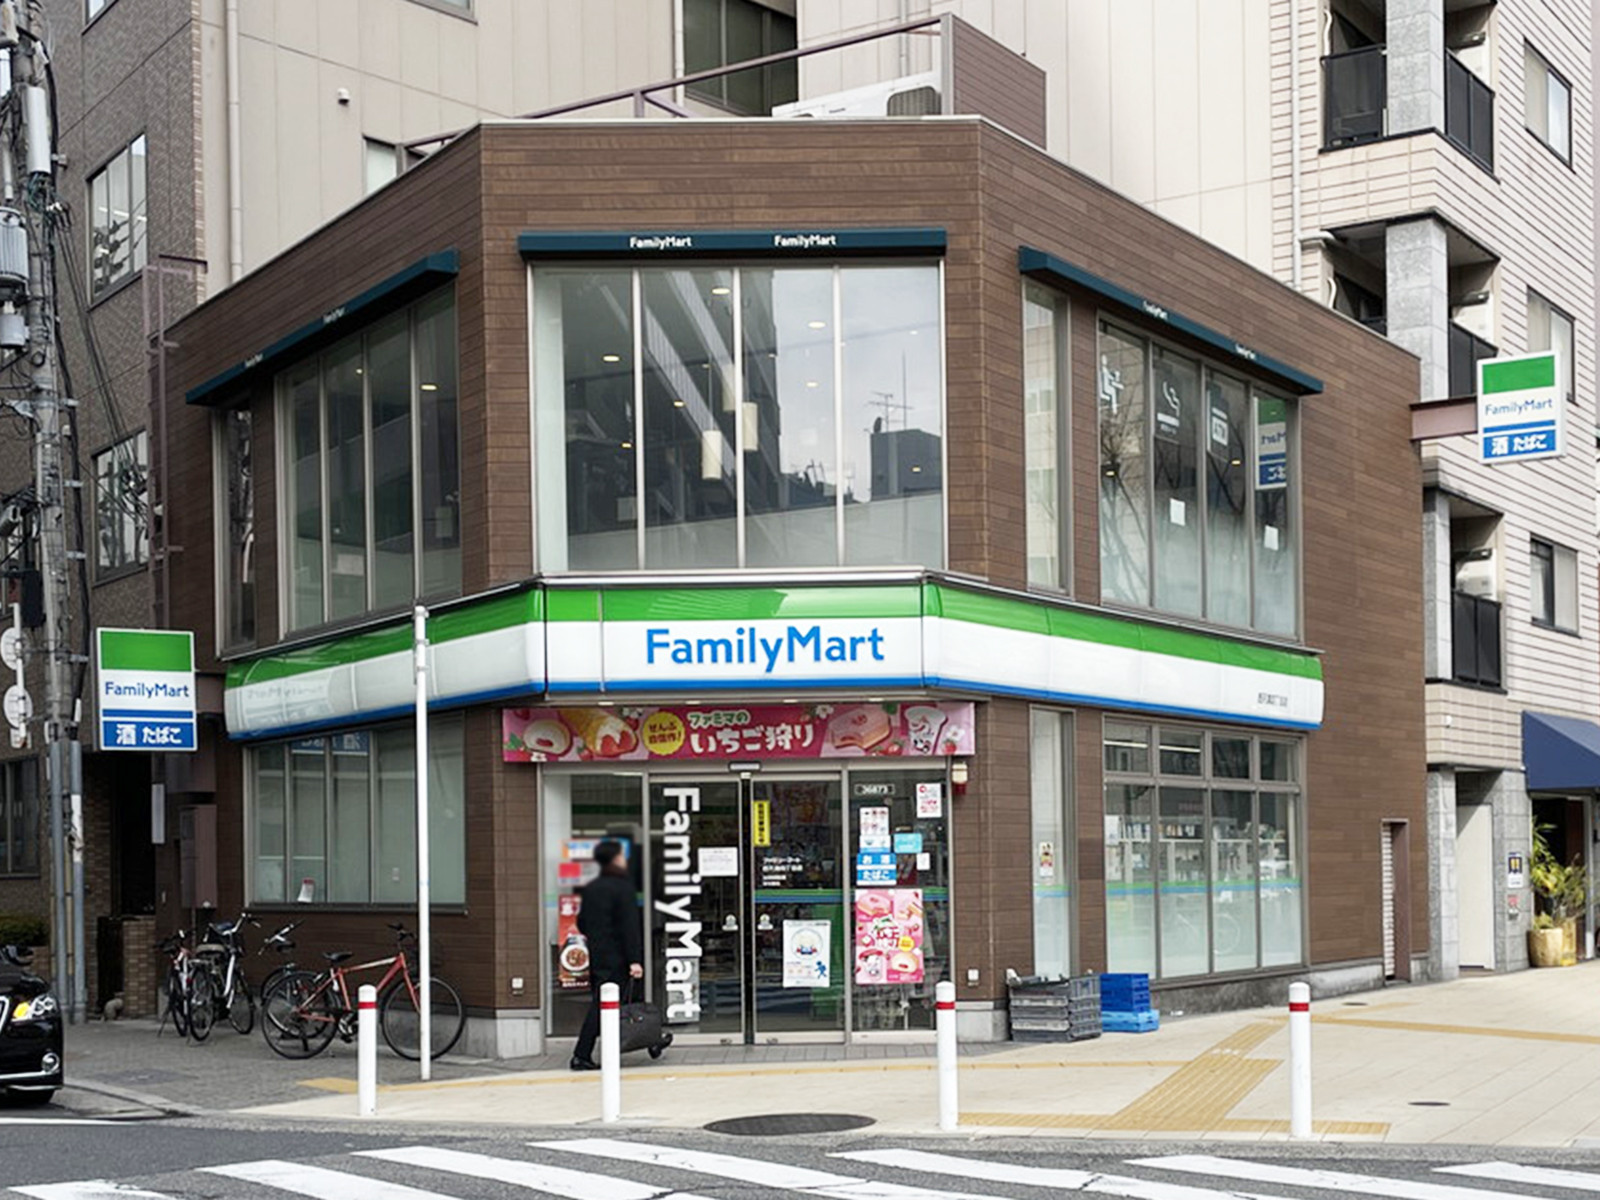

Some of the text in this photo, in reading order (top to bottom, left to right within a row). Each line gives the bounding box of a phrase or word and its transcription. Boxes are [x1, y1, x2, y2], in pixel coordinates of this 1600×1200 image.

[629, 237, 692, 250] FamilyMart
[775, 235, 837, 249] FamilyMart
[1484, 398, 1553, 416] FamilyMart
[1491, 433, 1548, 455] 酒 たばこ
[646, 625, 885, 673] FamilyMart
[105, 681, 190, 699] FamilyMart
[688, 709, 750, 728] ファミマの
[115, 723, 182, 745] 酒 たばこ
[690, 723, 814, 754] いちご狩り
[654, 787, 703, 1020] FamilyMart
